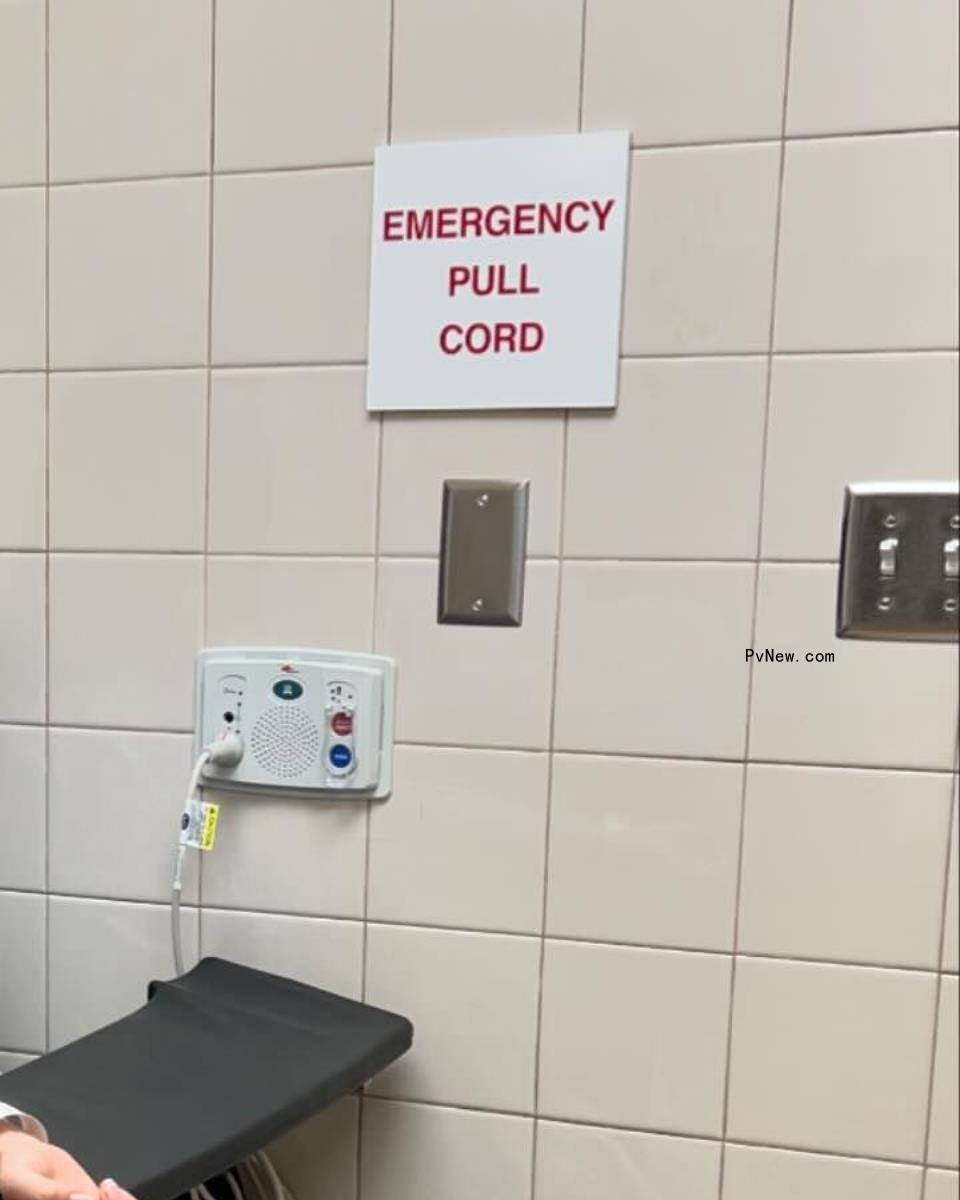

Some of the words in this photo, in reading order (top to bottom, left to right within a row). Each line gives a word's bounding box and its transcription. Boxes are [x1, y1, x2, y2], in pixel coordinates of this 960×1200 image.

[383, 199, 615, 241] EMERGENCY
[448, 263, 539, 296] PULL
[439, 322, 544, 354] CORD
